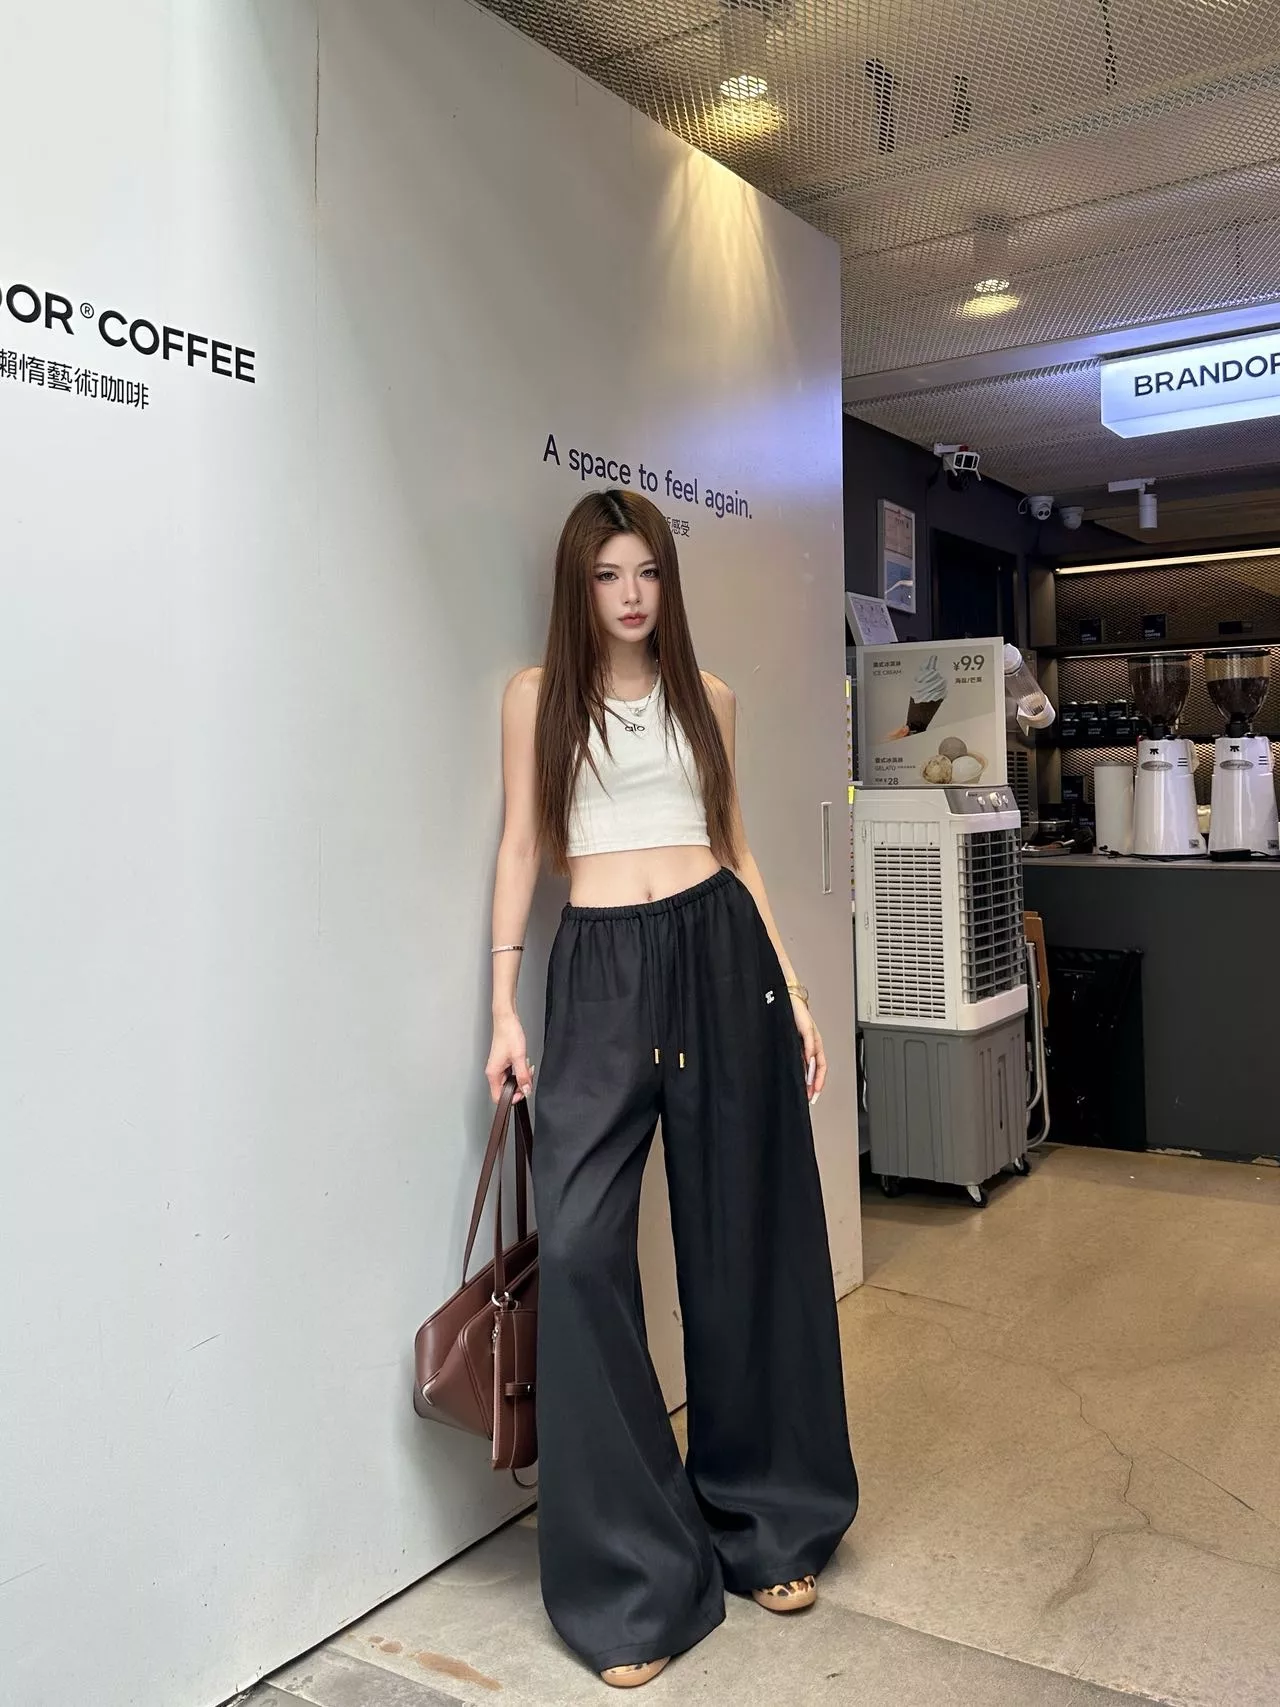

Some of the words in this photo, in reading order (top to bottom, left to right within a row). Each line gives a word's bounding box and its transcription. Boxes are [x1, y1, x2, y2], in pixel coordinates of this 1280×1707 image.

[98, 310, 256, 384] COFFEE
[542, 434, 561, 466] A
[568, 448, 631, 485] space
[638, 463, 658, 493] to
[665, 469, 699, 505] feel
[704, 488, 753, 519] again.
[953, 655, 985, 671] ¥9.9
